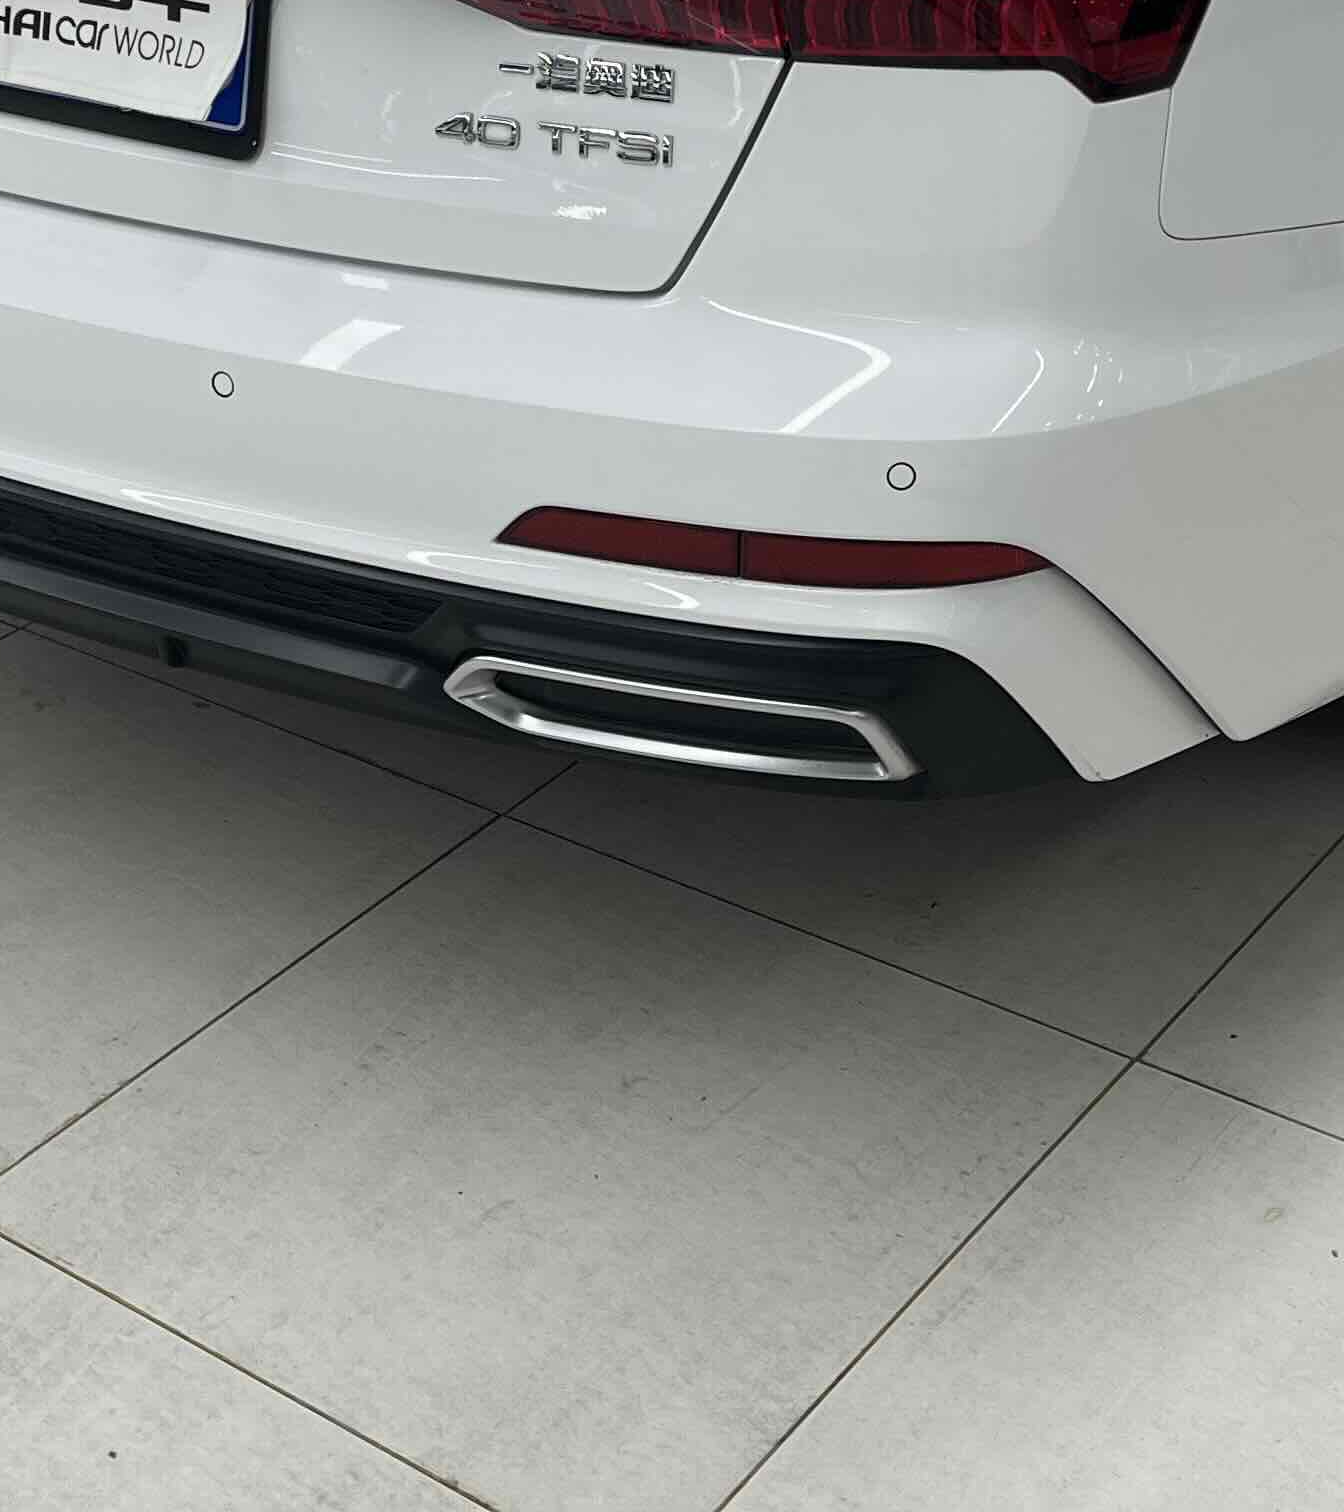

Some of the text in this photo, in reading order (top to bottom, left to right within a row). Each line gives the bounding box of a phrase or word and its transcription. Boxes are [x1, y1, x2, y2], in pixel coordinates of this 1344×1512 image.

[55, 15, 110, 51] car
[114, 25, 206, 70] WORLD
[434, 112, 521, 151] 40
